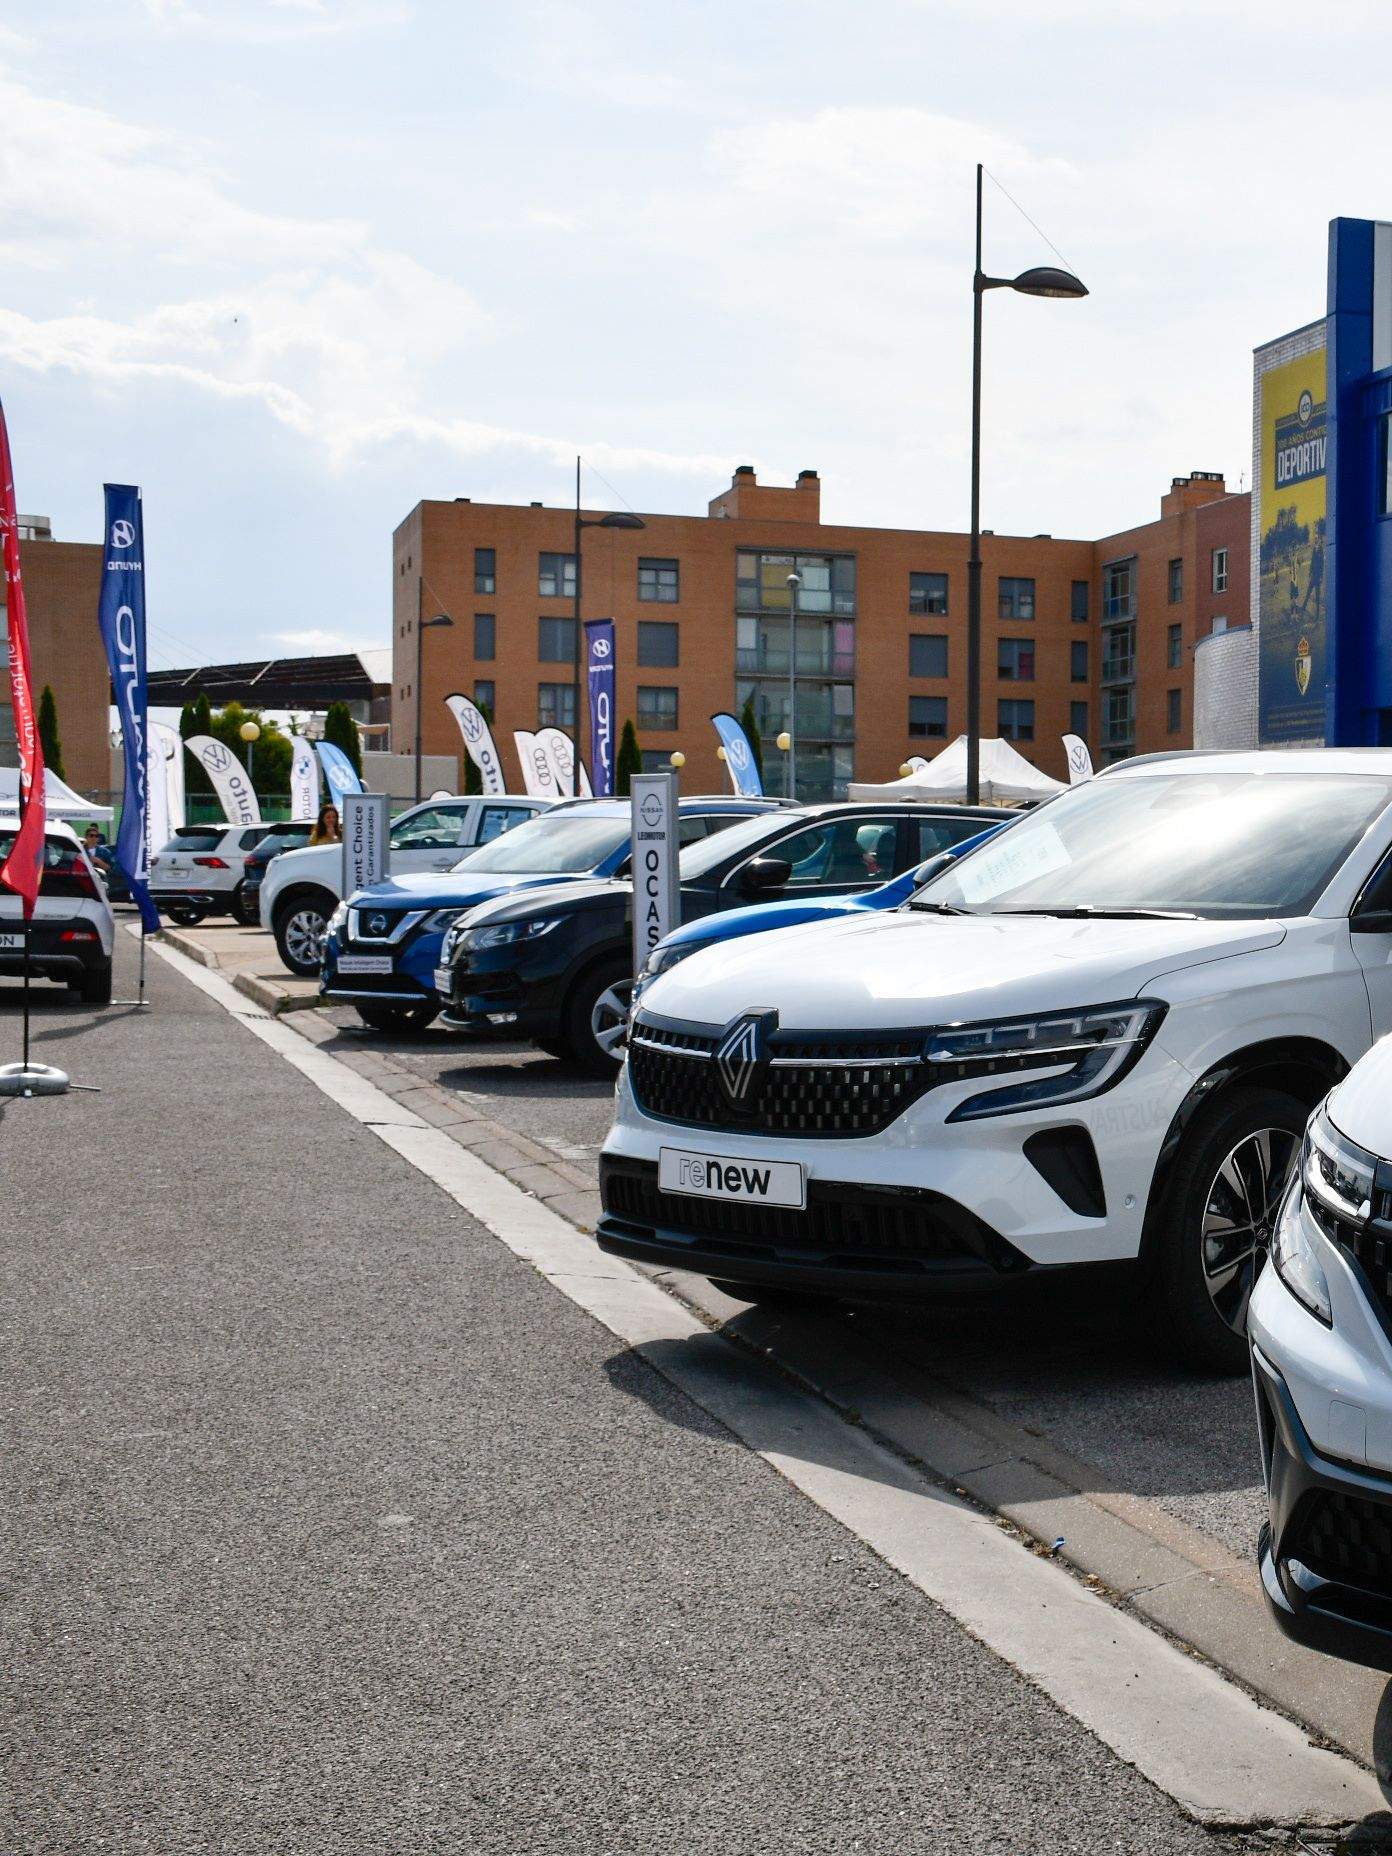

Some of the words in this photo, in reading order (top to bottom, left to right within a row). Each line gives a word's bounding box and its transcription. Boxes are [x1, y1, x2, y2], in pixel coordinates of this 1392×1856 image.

[1277, 437, 1327, 482] DEPORTIV
[353, 805, 364, 854] Choice
[367, 805, 375, 877] Garantizados
[355, 862, 364, 891] gent
[645, 849, 659, 948] OCAS
[679, 1158, 771, 1195] renew
